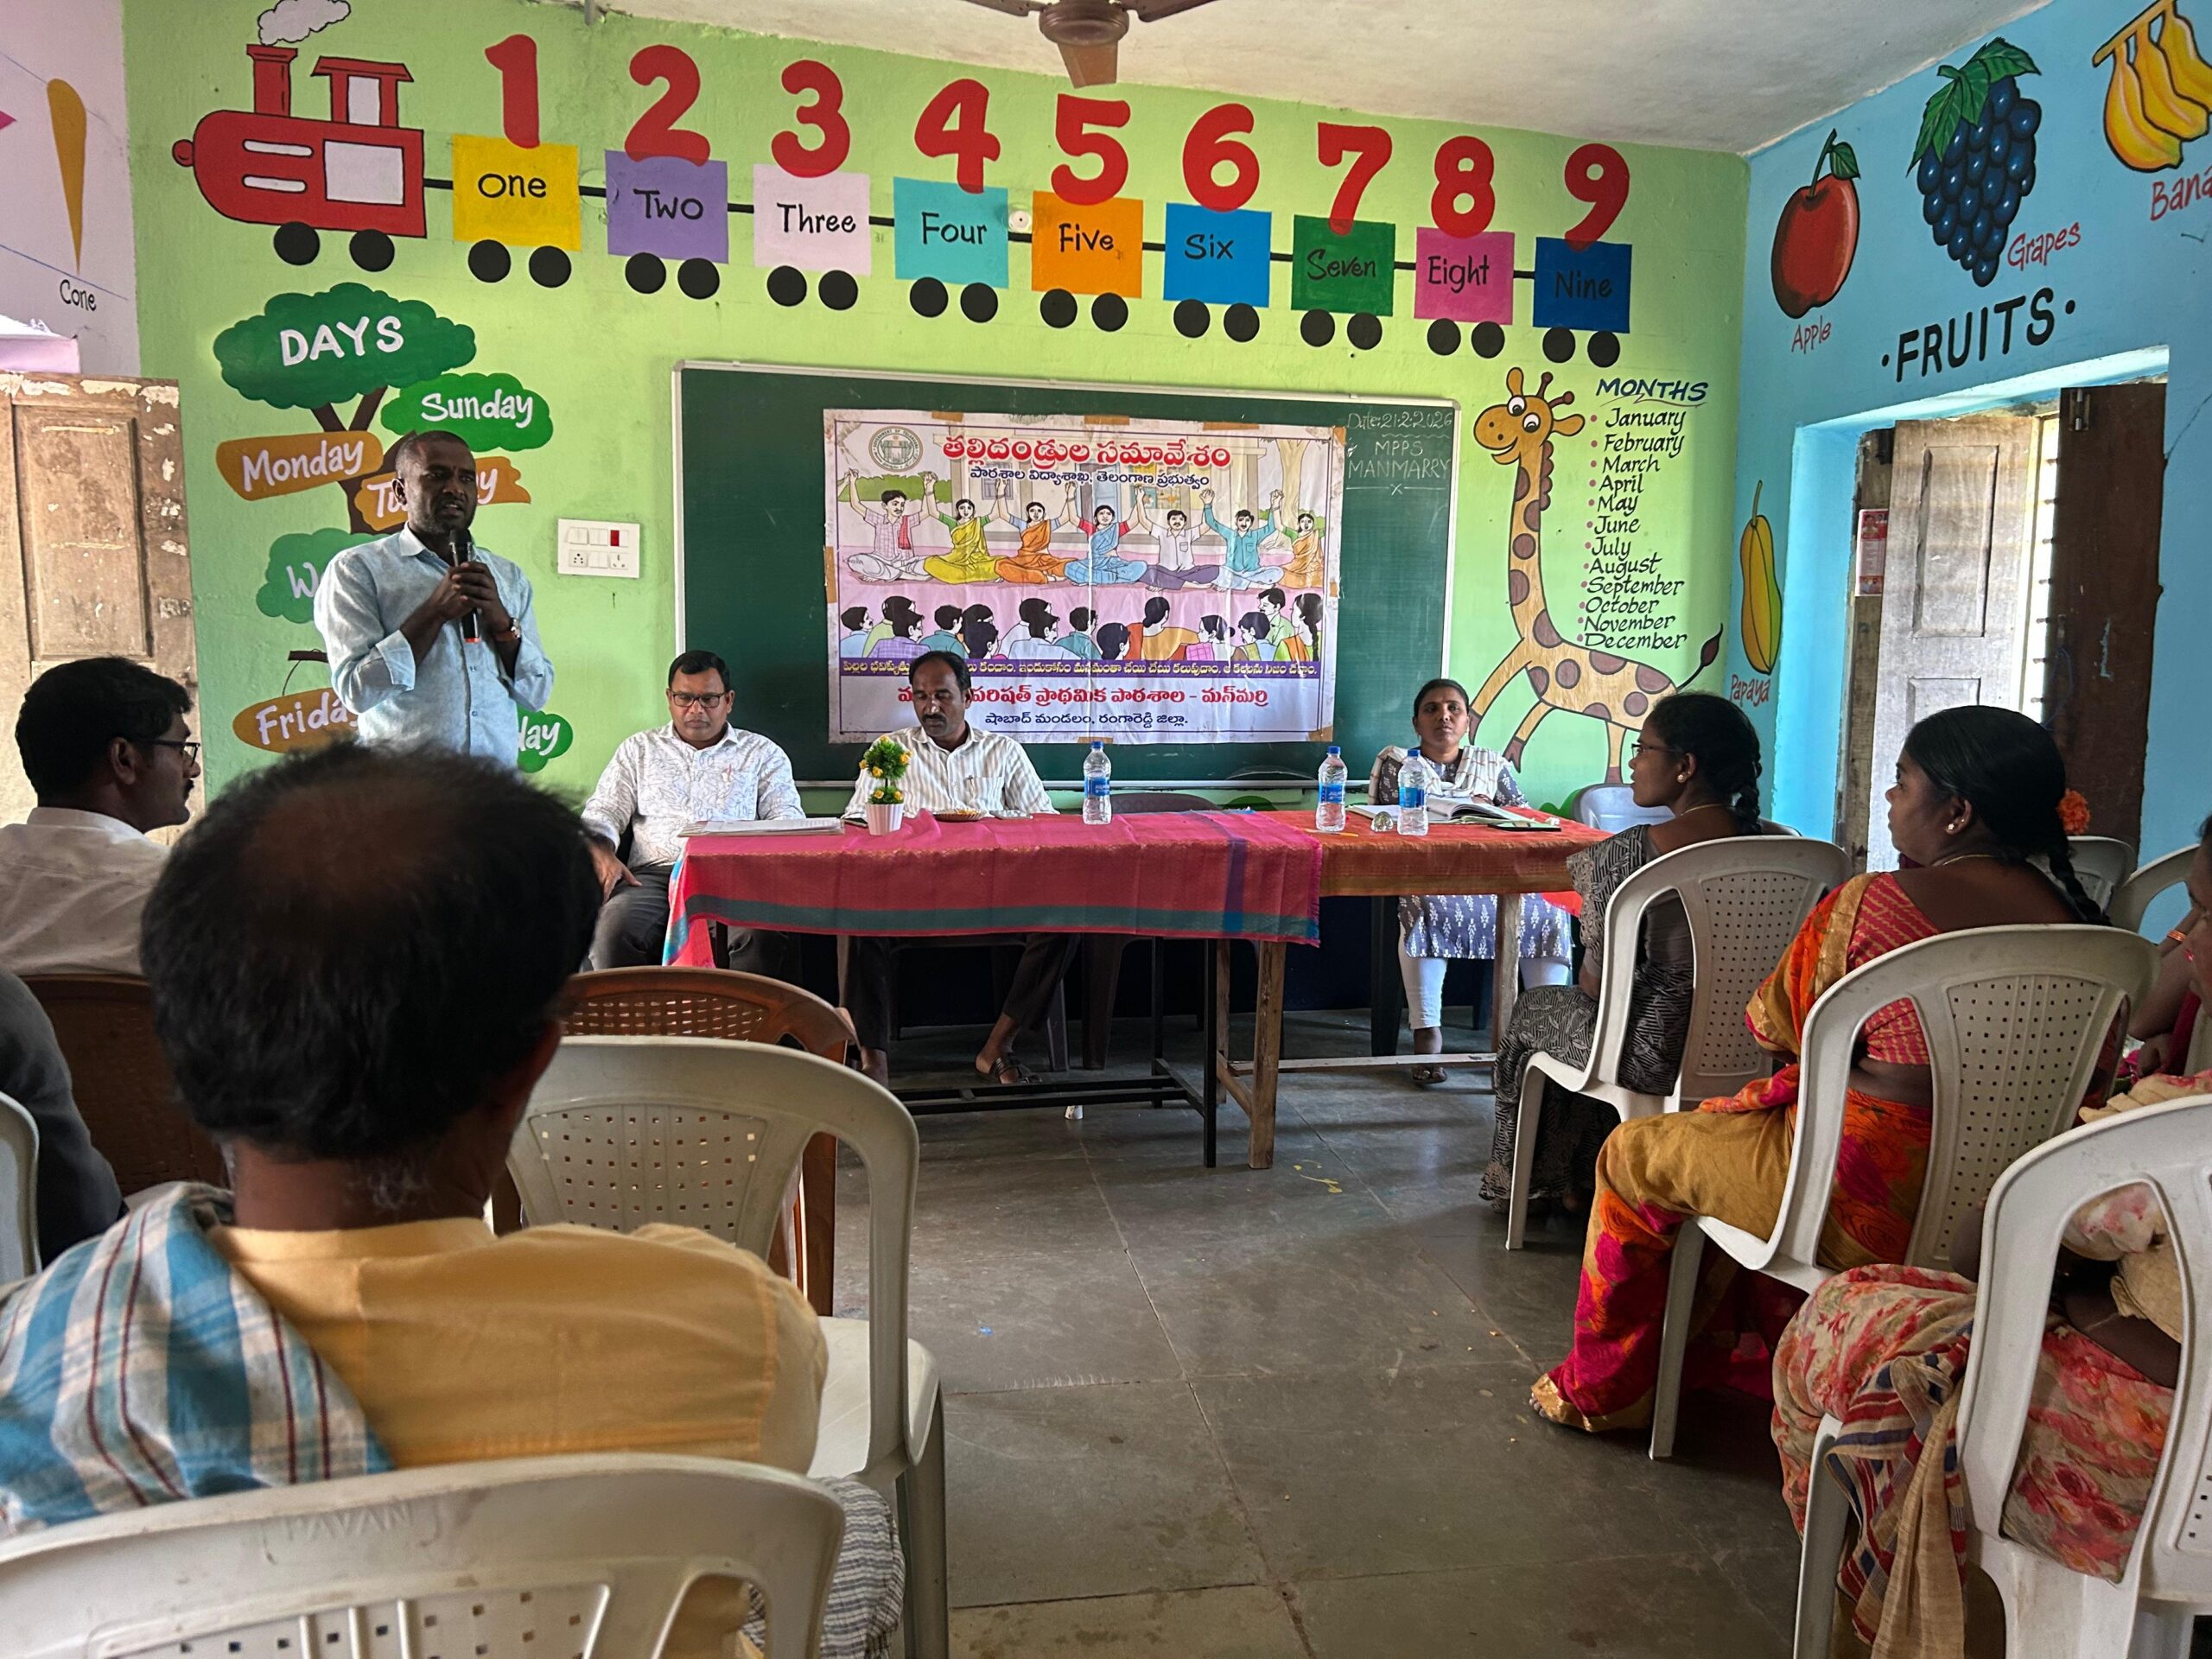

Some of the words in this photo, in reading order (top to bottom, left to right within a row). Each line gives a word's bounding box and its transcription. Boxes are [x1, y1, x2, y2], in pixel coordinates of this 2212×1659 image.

[485, 35, 540, 149] 1
[625, 44, 710, 166] 2
[772, 60, 850, 178] 3
[914, 79, 1001, 194] 4
[1051, 93, 1131, 206] 5
[1182, 104, 1259, 212] 6
[1316, 122, 1392, 236] 7
[1431, 135, 1495, 238] 8
[633, 189, 703, 220] Two
[1563, 143, 1630, 251] 9
[777, 203, 855, 234] Three
[921, 212, 987, 245] Four
[1058, 224, 1114, 253] Five
[1185, 232, 1233, 261] Six
[2007, 221, 2082, 270] Grapes
[1306, 249, 1376, 280] Seven
[1427, 255, 1490, 293] Eight
[59, 279, 97, 313] Cone
[1555, 270, 1612, 300] Nine
[280, 315, 404, 366] DAYS
[1791, 316, 1832, 353] Apple
[1596, 378, 1708, 402] MONTHS
[421, 389, 534, 429] Sunday
[1605, 408, 1686, 435] January
[943, 435, 1090, 469] తల్లిదండ్రుల
[1097, 439, 1230, 467] సమావేశం
[1375, 440, 1423, 456] MPPS
[1604, 433, 1685, 458] February
[242, 440, 364, 492] Monday
[1348, 458, 1451, 480] MANMARRY
[1602, 454, 1660, 474] March
[1096, 471, 1154, 484] తెలంగాణ
[1156, 473, 1209, 490] ప్రభుత్వం
[1599, 473, 1643, 497] April
[1598, 495, 1638, 516] May
[1594, 515, 1641, 534] June
[1592, 536, 1630, 561] July
[1589, 551, 1662, 579] August
[1586, 575, 1684, 599] September
[1586, 596, 1659, 613] October
[1584, 613, 1675, 632] November
[1585, 632, 1688, 650] December
[1111, 687, 1185, 702] పాఠశాల
[1730, 673, 1770, 708] Papaya
[256, 691, 358, 745] Frida
[985, 712, 1032, 726] షాబాద్
[1099, 712, 1153, 728] రంగారెడ్డి
